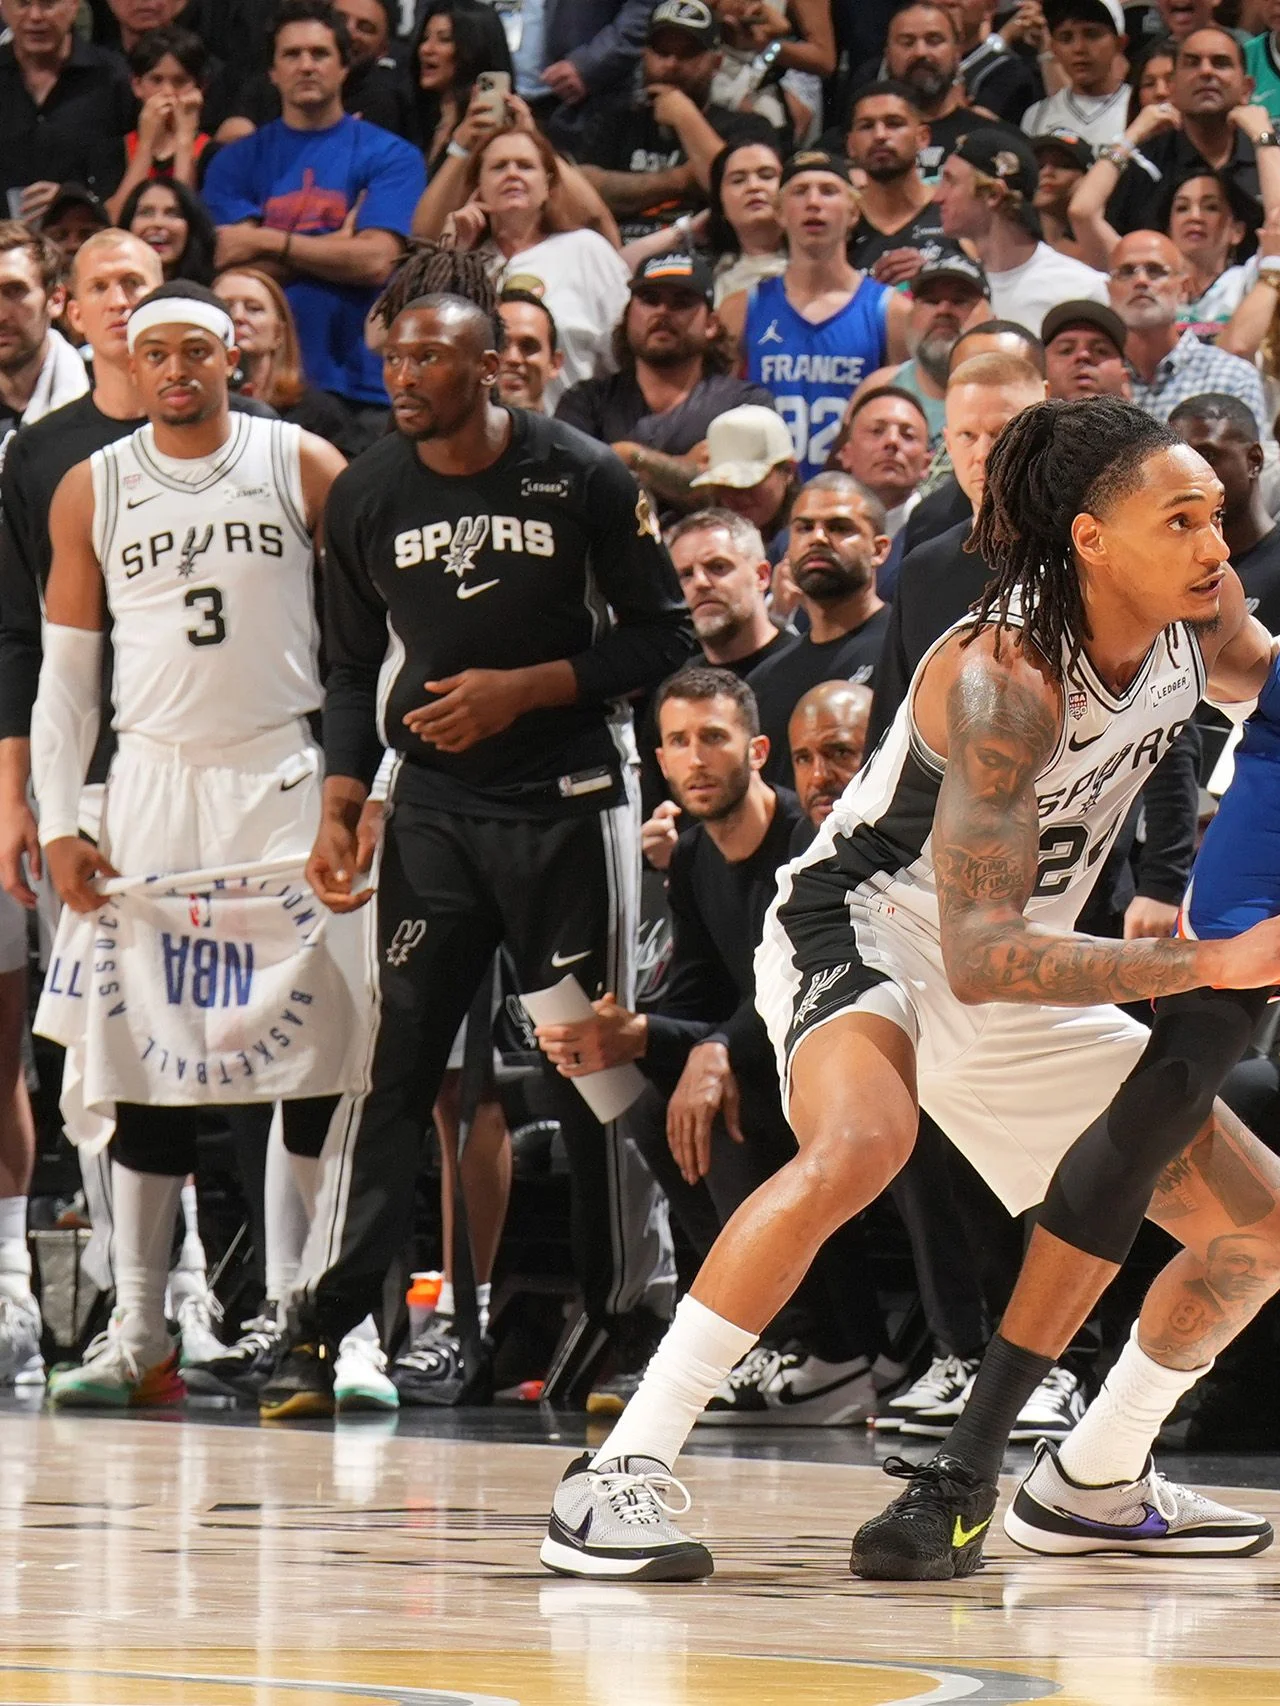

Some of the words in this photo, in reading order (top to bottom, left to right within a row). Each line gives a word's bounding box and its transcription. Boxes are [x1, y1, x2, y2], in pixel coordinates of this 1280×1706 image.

[761, 354, 865, 385] FRANCE
[122, 521, 283, 580] SPURS
[394, 515, 555, 578] SPURS
[183, 585, 227, 648] 3
[1069, 693, 1086, 702] USA
[1069, 707, 1088, 717] 250
[1156, 677, 1187, 700] LEDGER
[161, 933, 255, 1009] NBA
[140, 988, 314, 1084] BASKETBALL
